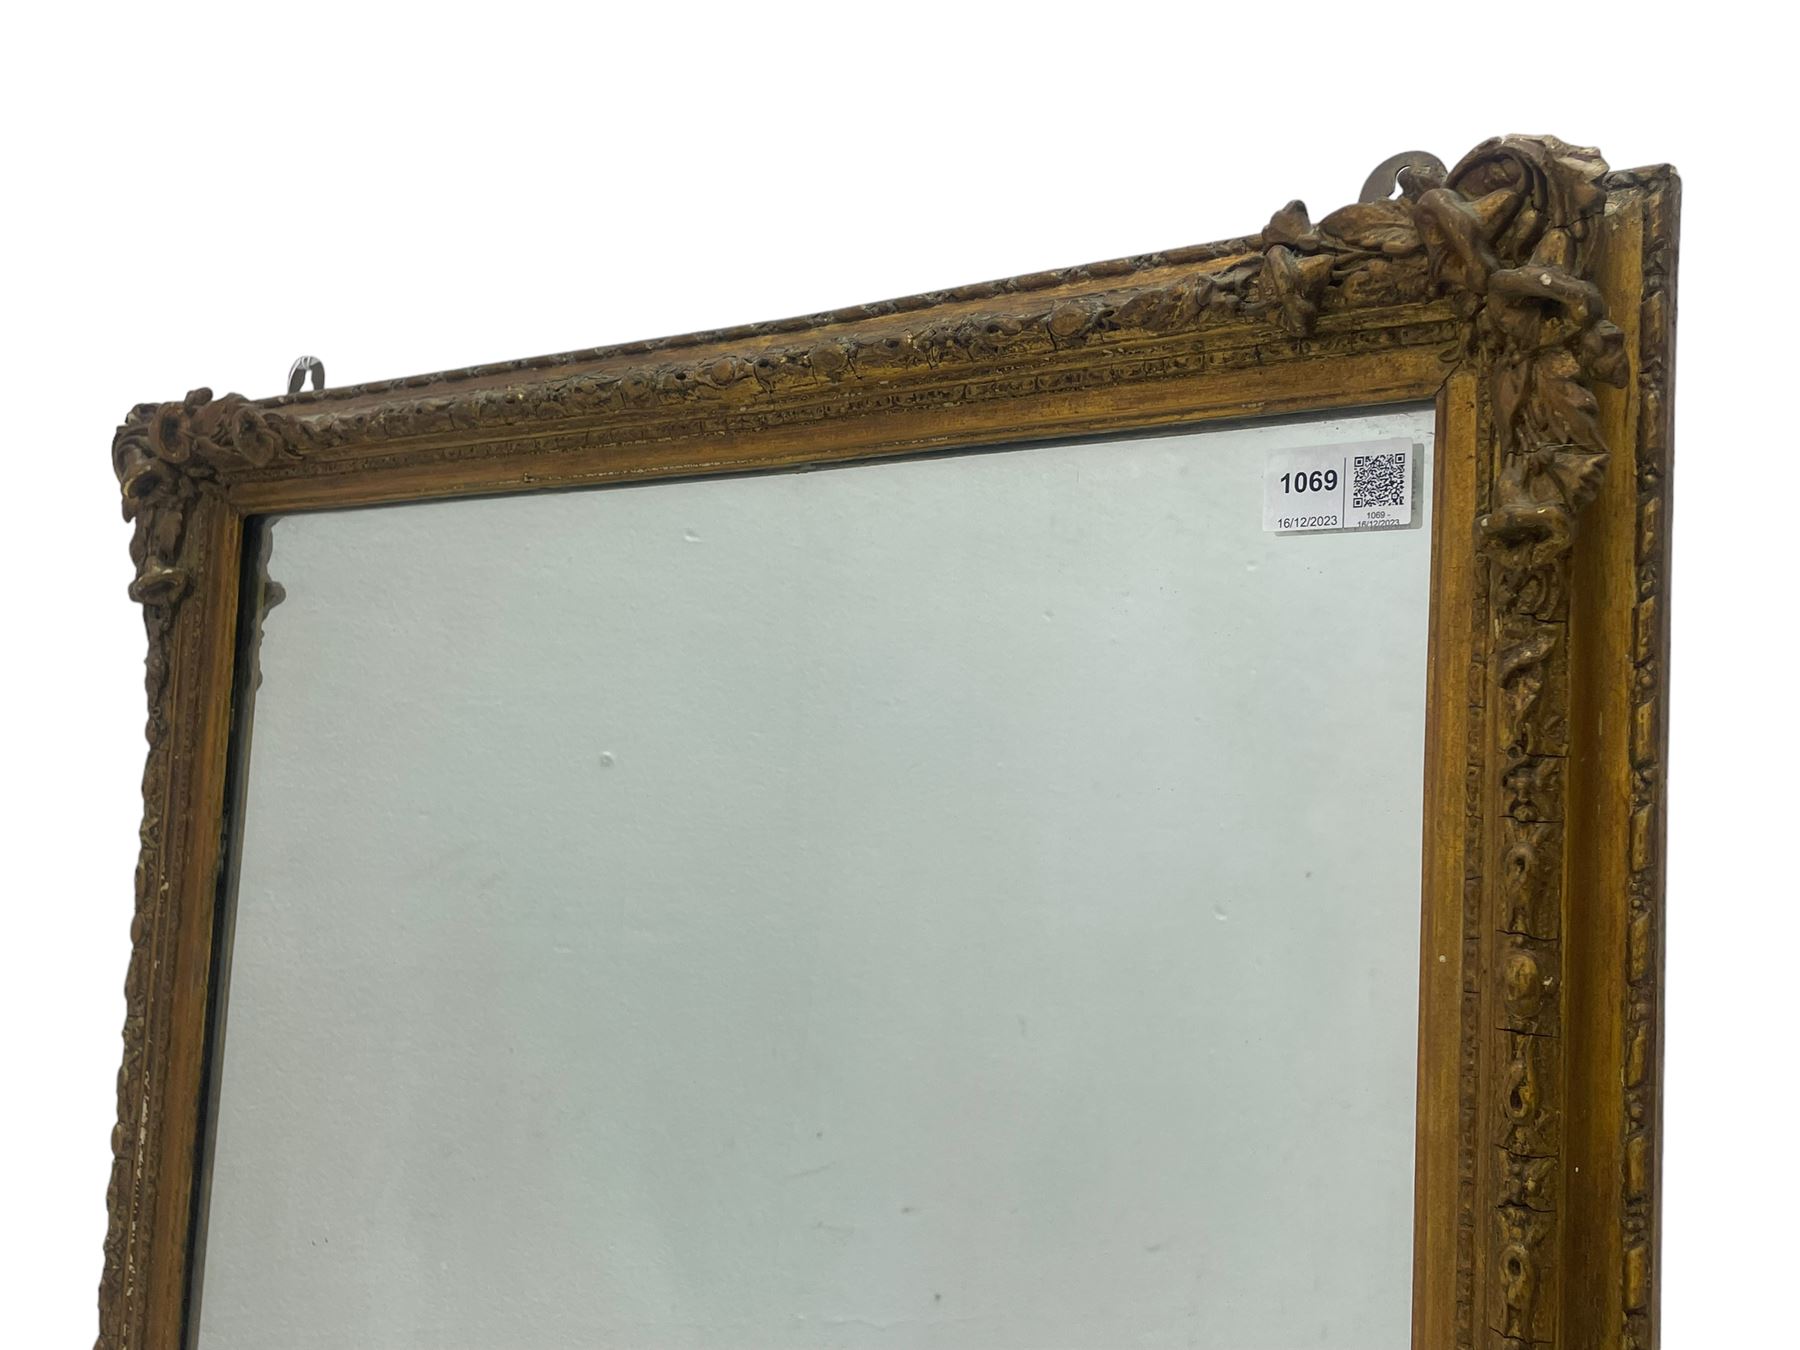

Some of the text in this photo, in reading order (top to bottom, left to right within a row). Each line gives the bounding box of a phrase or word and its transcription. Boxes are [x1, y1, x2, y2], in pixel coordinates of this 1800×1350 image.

[1280, 469, 1338, 494] 1069
[1277, 515, 1338, 529] 16/12/2023
[1367, 511, 1385, 519] 1069
